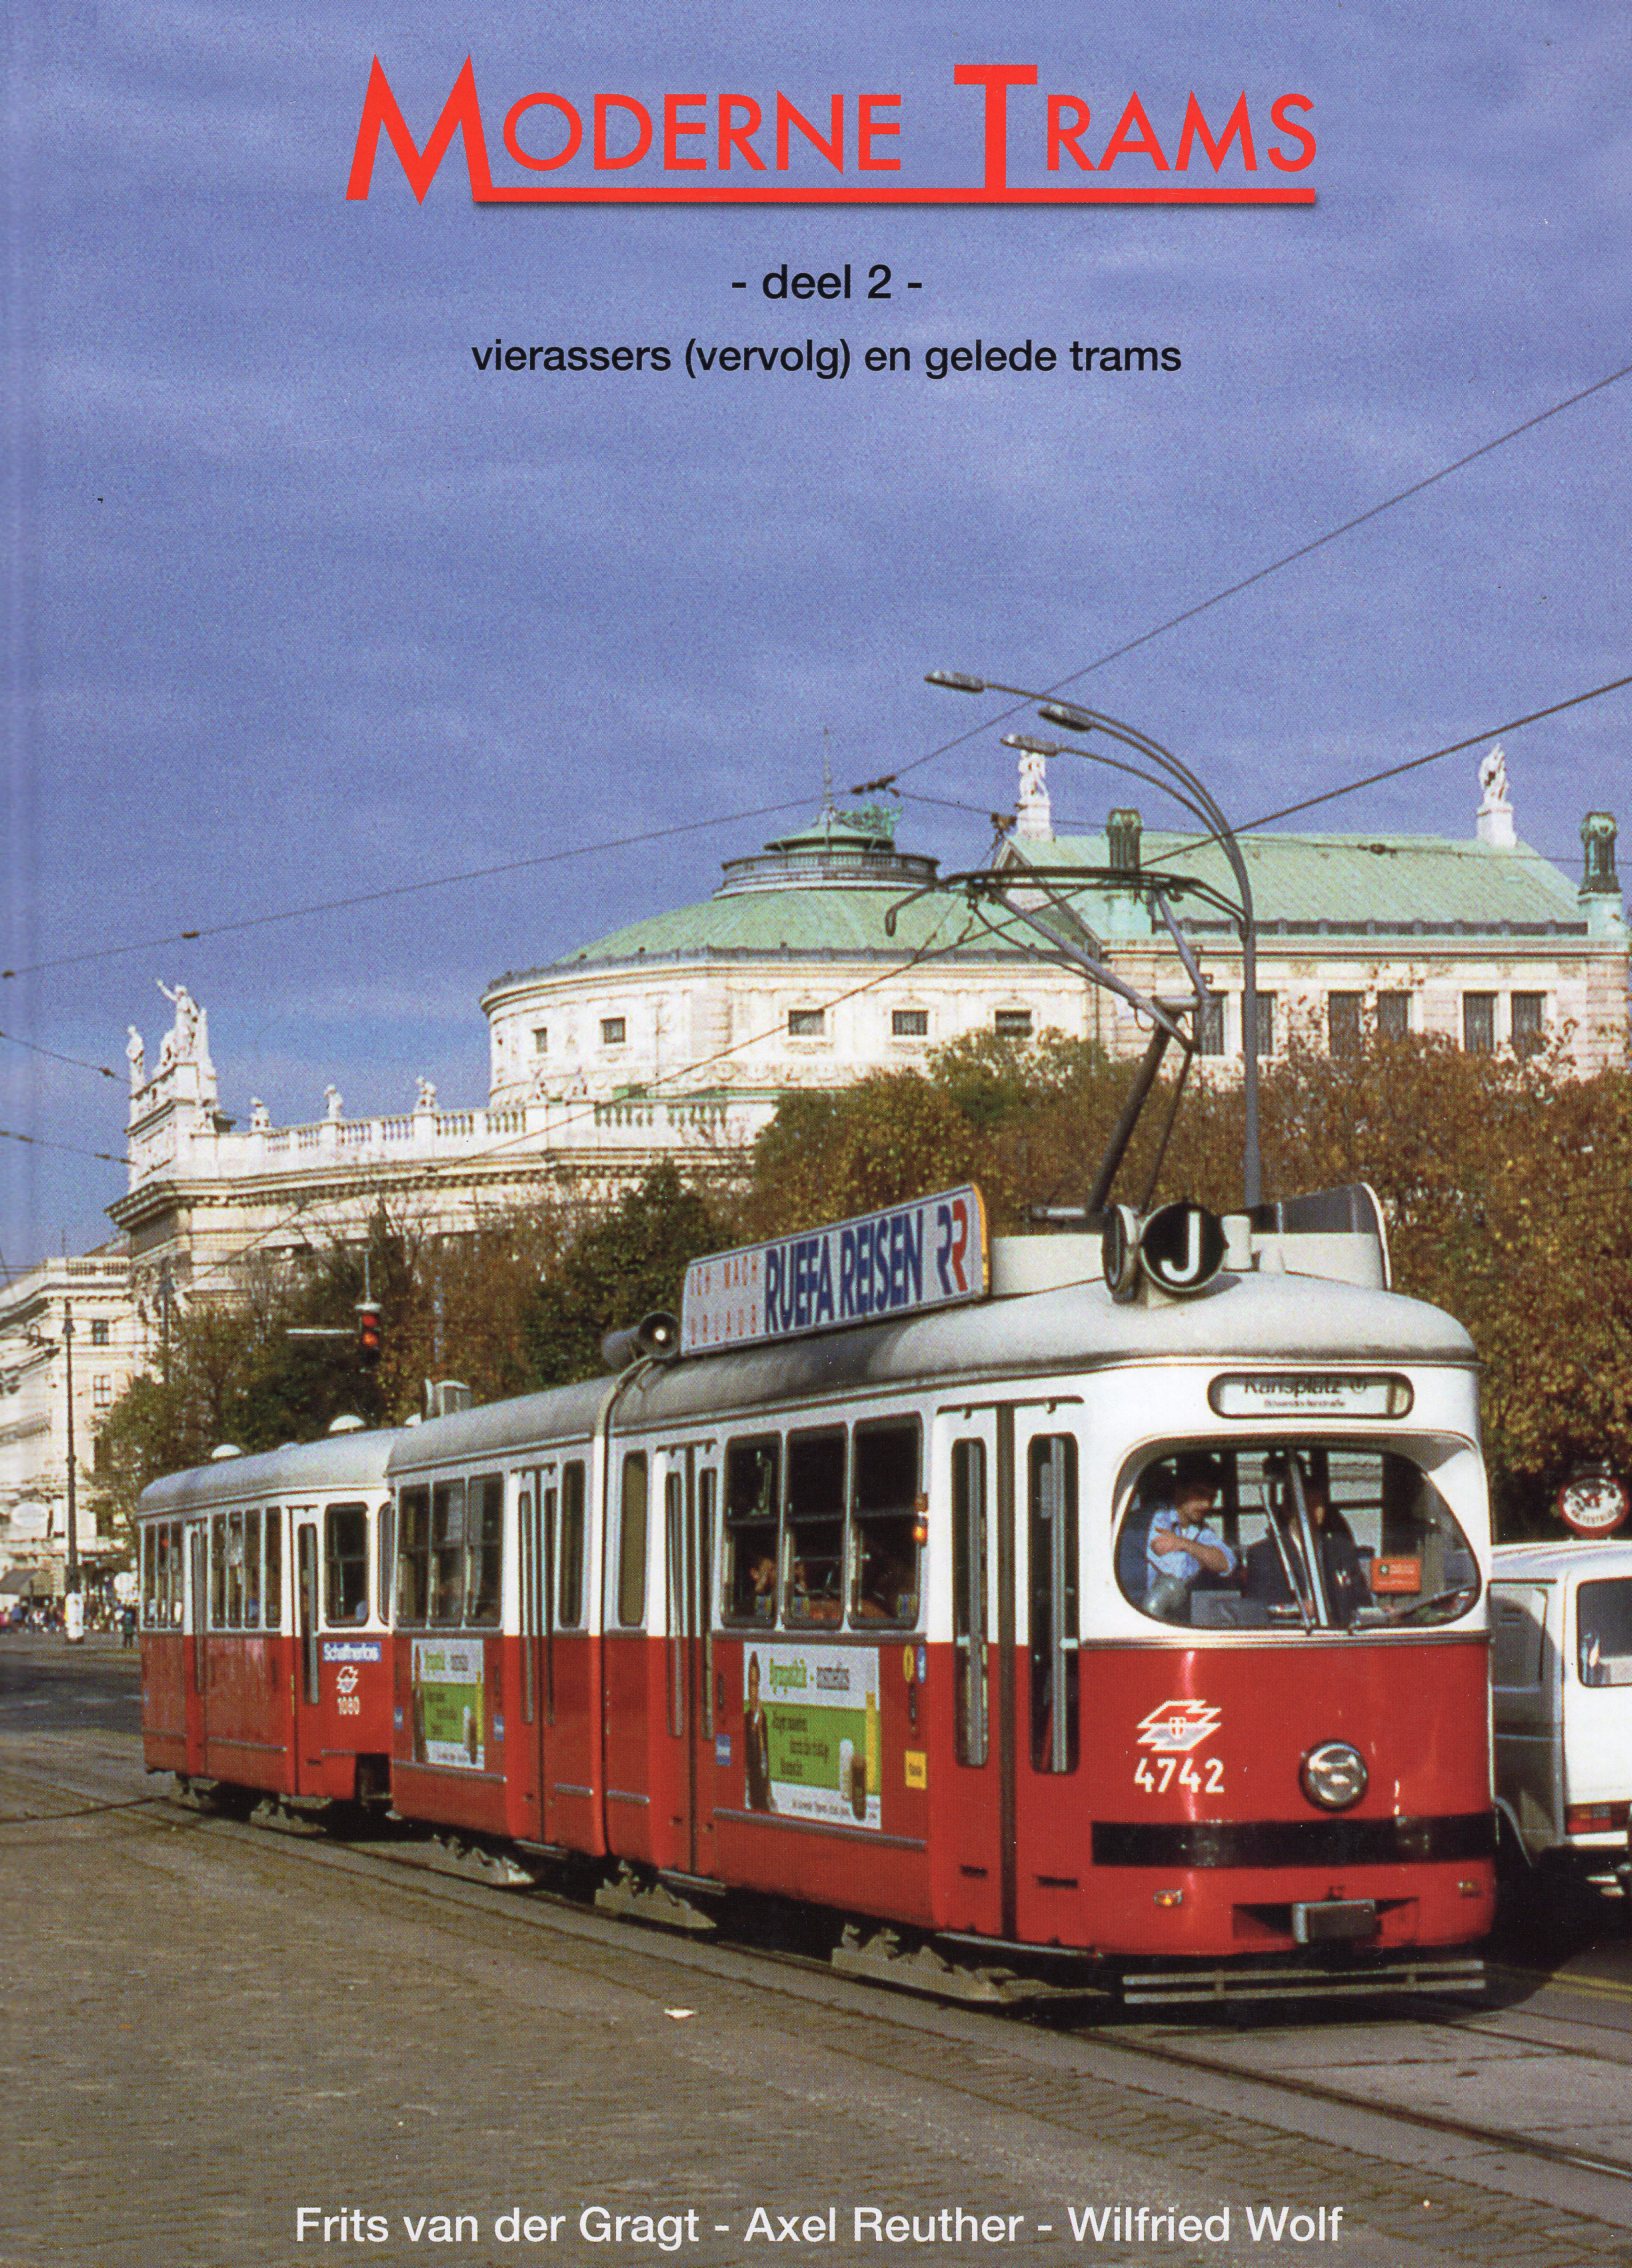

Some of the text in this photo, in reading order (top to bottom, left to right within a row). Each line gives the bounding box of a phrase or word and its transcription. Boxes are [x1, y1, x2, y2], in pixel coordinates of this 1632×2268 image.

[764, 1233, 834, 1334] RUEFA
[839, 1207, 925, 1319] REISEN
[1160, 1210, 1201, 1283] J
[1133, 1757, 1225, 1794] 4742
